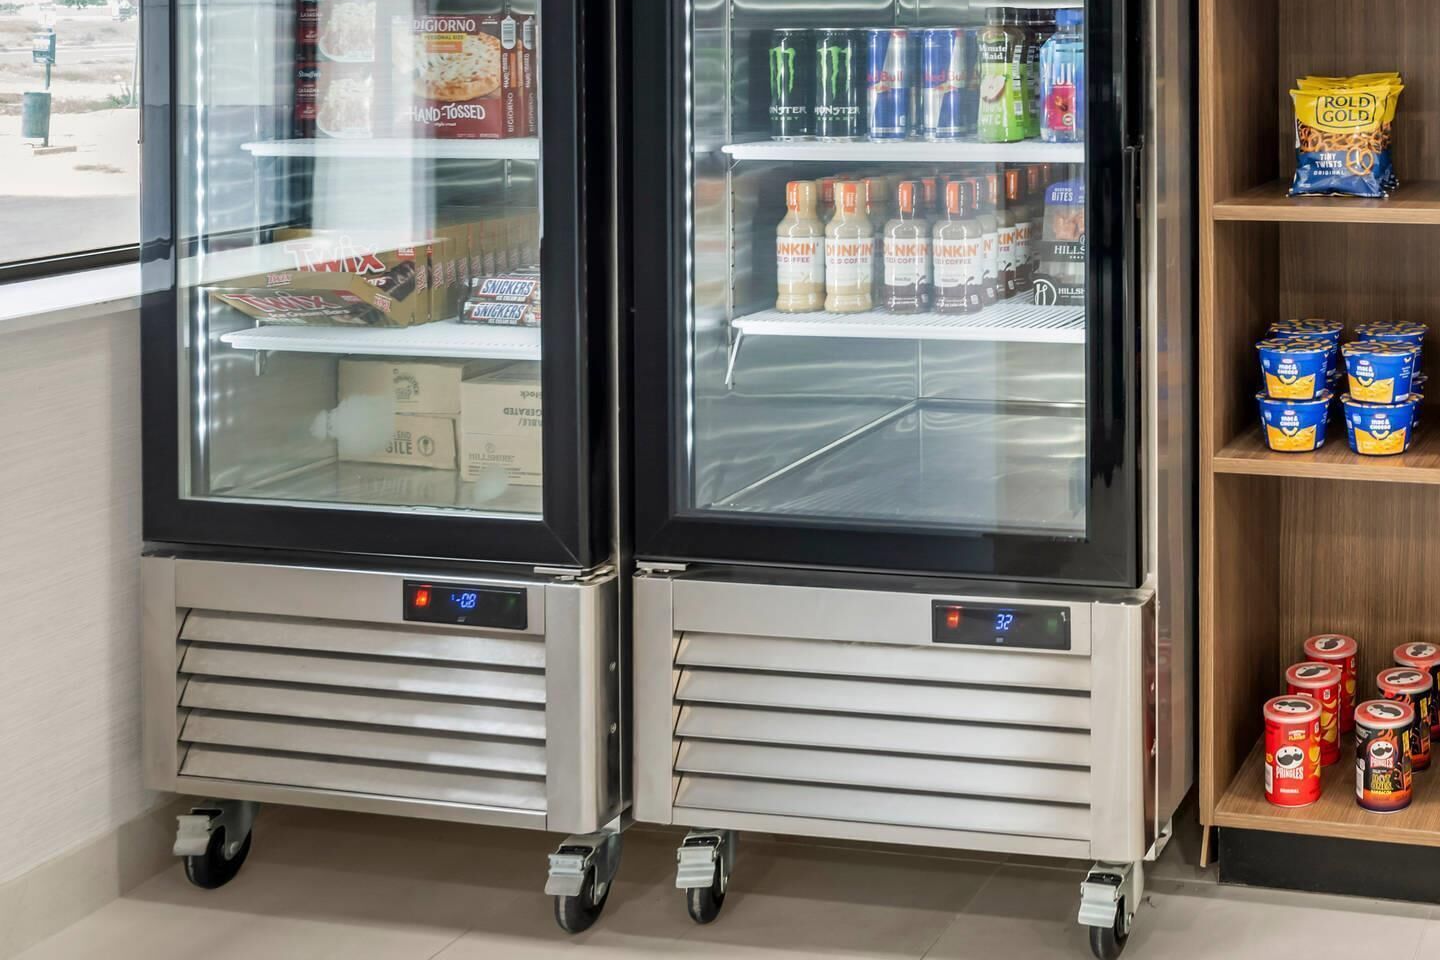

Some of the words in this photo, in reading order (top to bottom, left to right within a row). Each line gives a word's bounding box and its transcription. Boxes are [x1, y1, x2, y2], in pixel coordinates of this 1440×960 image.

[1324, 96, 1370, 108] ROLD
[1322, 109, 1370, 122] GOLD
[482, 280, 533, 296] SNICKERS
[473, 304, 526, 319] SNICKERS
[996, 613, 1014, 630] 32
[1370, 756, 1394, 769] PRINGLES
[1275, 766, 1304, 780] PRINGLES
